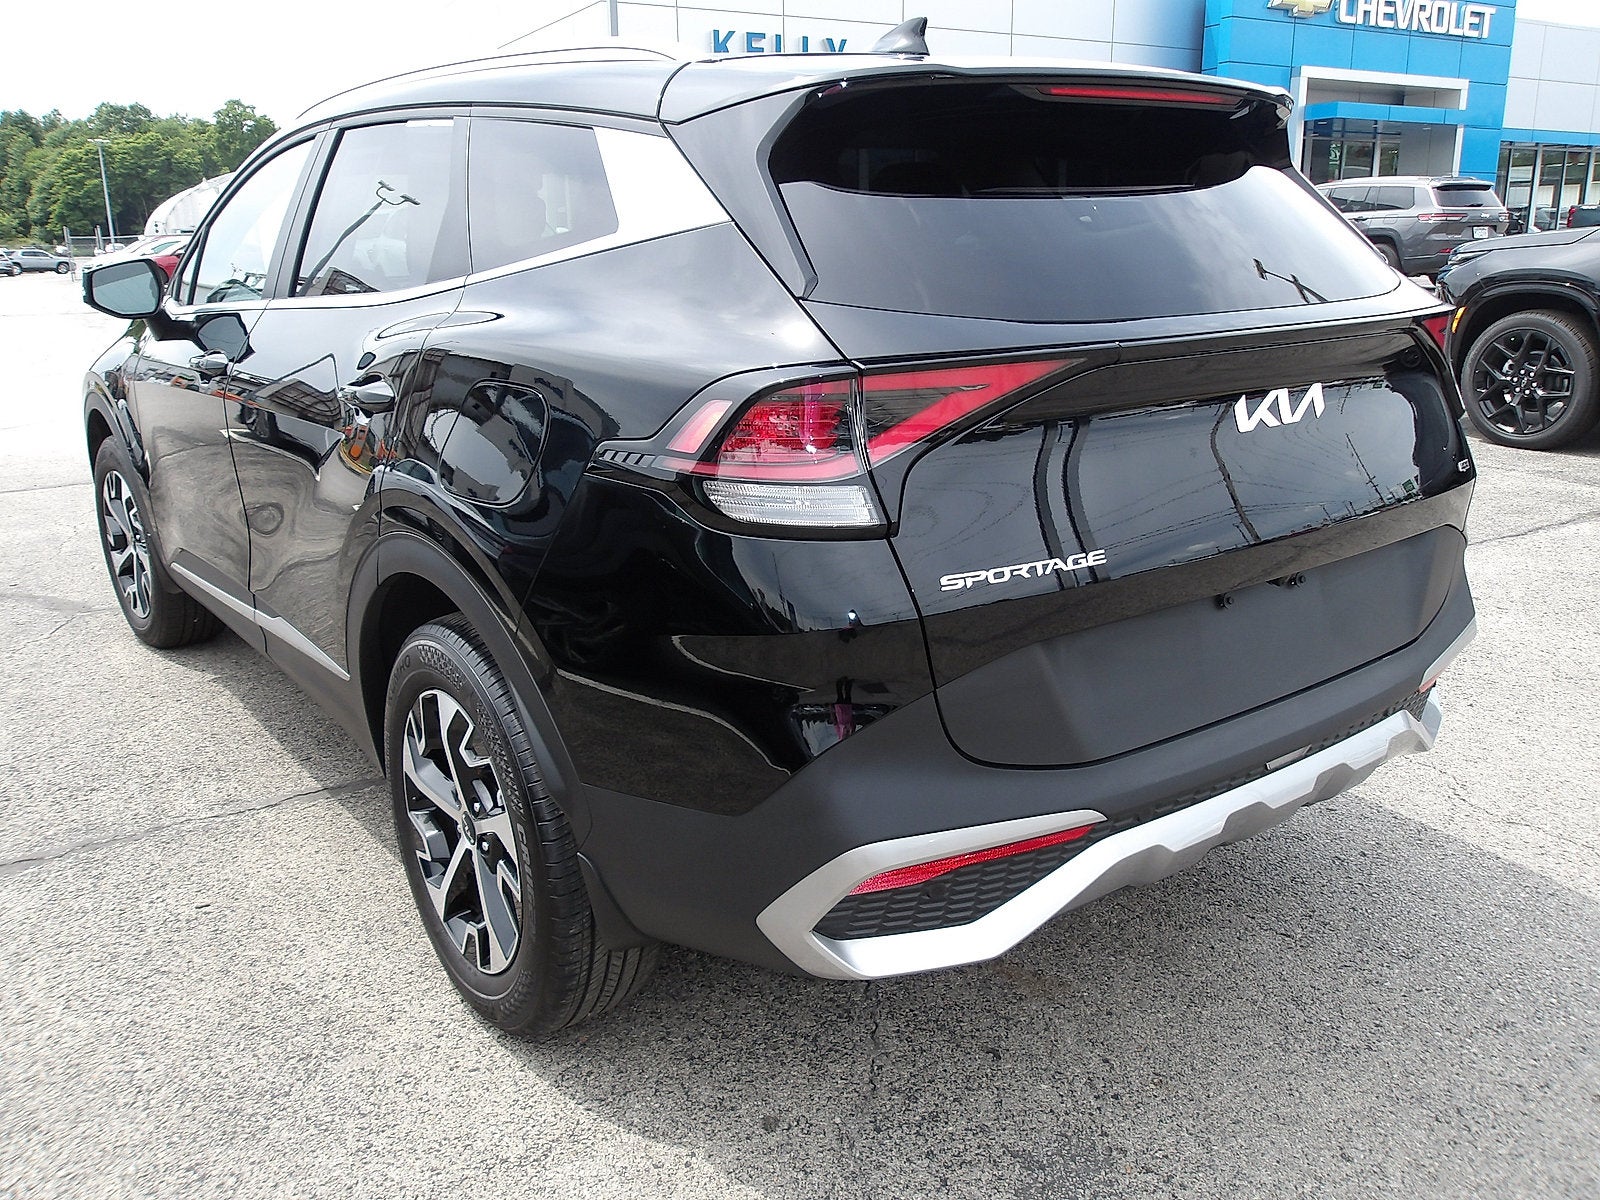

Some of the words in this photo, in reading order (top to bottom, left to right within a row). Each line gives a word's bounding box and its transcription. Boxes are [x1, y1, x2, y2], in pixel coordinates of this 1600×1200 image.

[1338, 0, 1497, 39] CHEVROLET
[1233, 382, 1326, 433] KIA
[938, 549, 1108, 593] SPORTAGE
